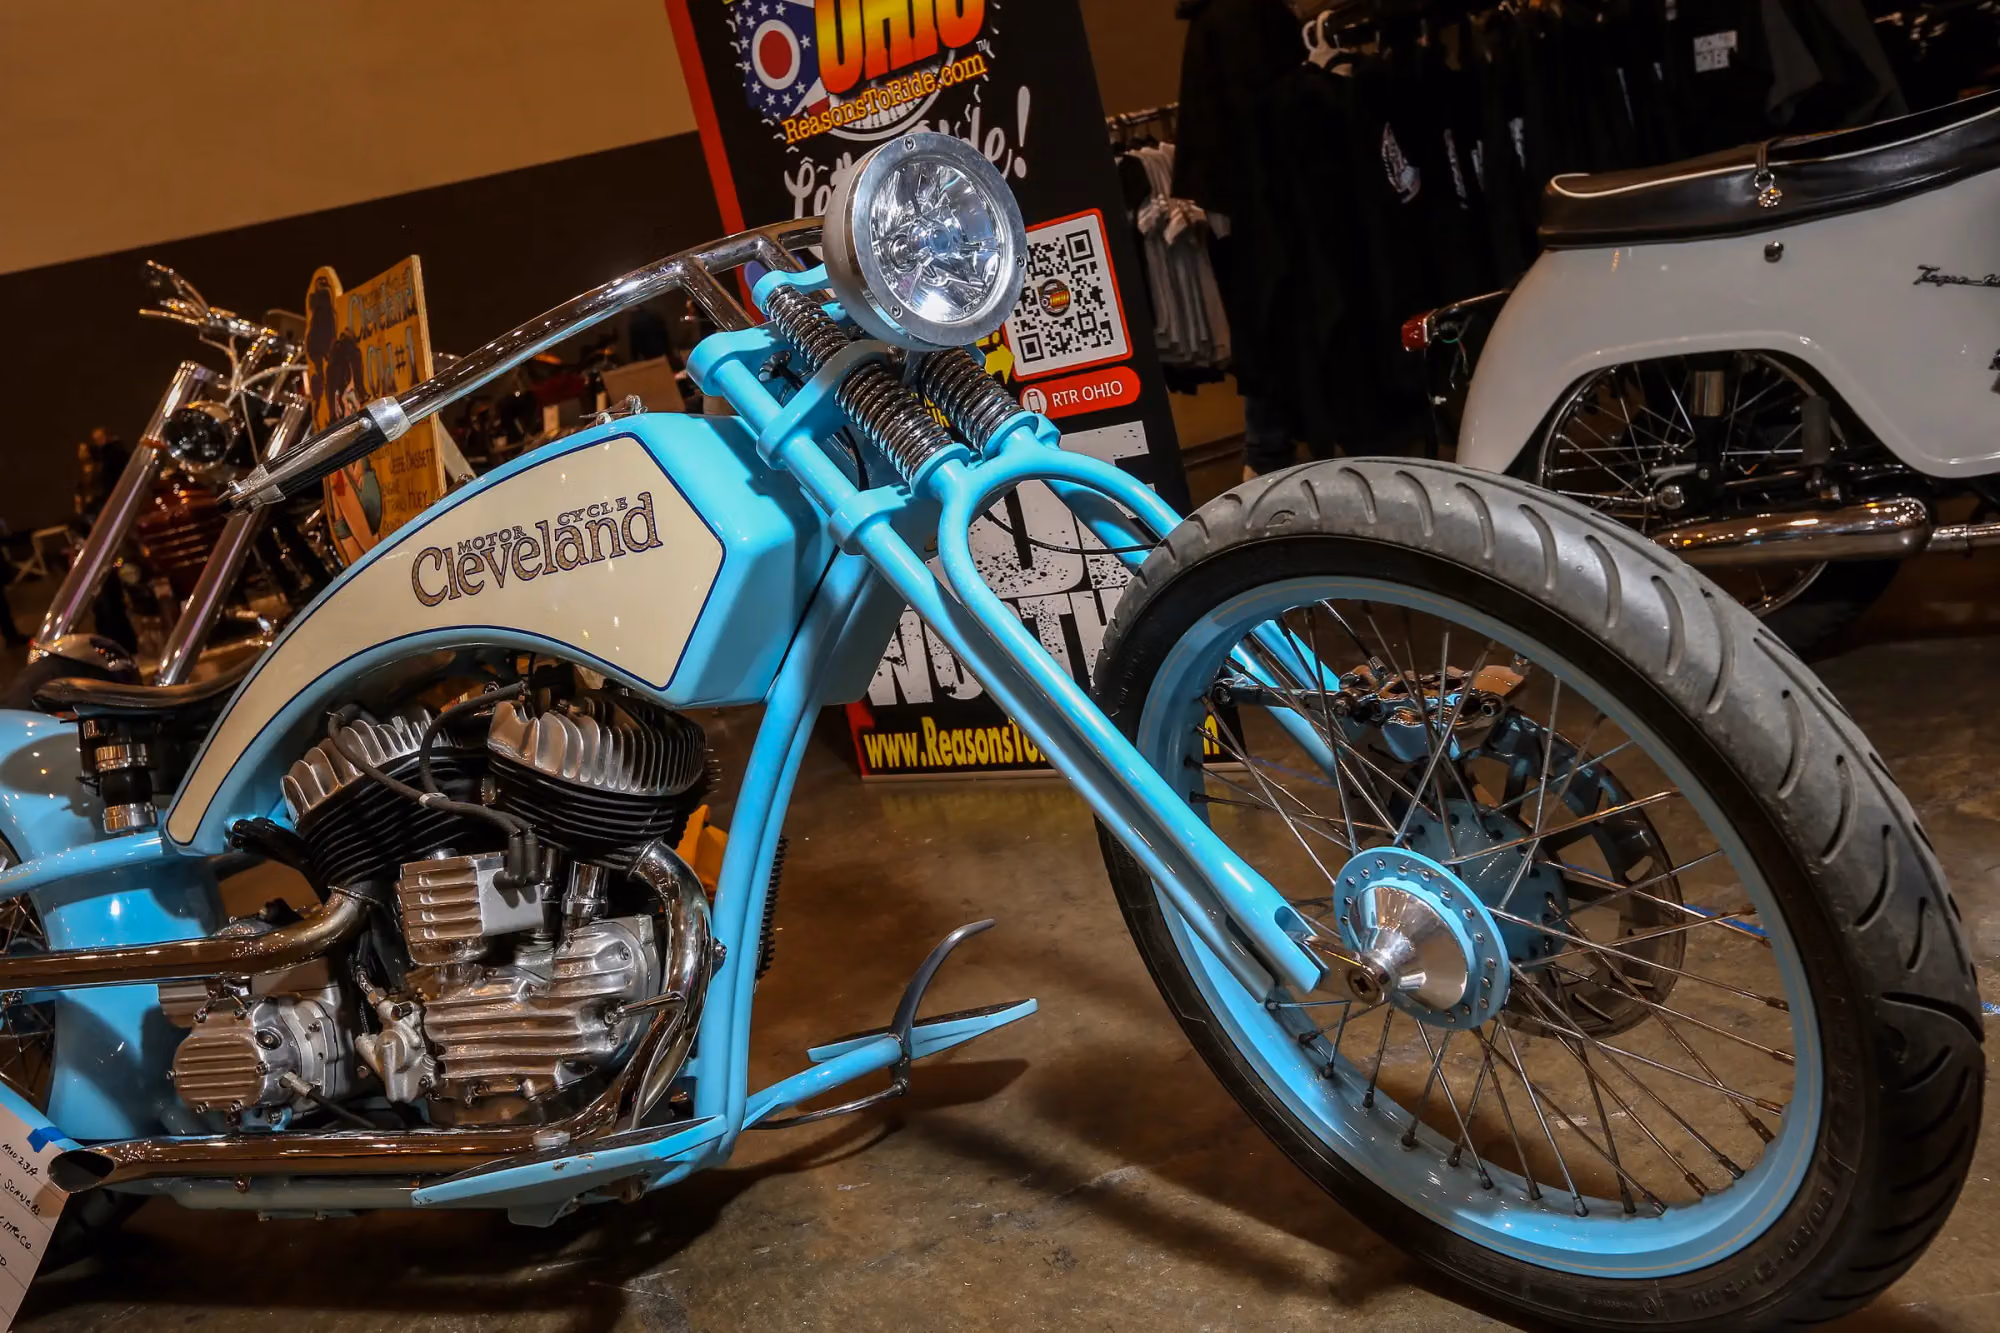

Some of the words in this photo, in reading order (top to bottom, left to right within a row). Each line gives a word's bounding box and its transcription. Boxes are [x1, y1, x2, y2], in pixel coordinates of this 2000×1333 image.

[783, 54, 988, 144] ReasonsToRide.com
[1051, 390, 1080, 407] RTR
[1082, 380, 1123, 401] OHIO
[411, 491, 664, 607] Cleveland
[457, 525, 527, 556] MOTOR
[556, 496, 628, 526] CYCLE
